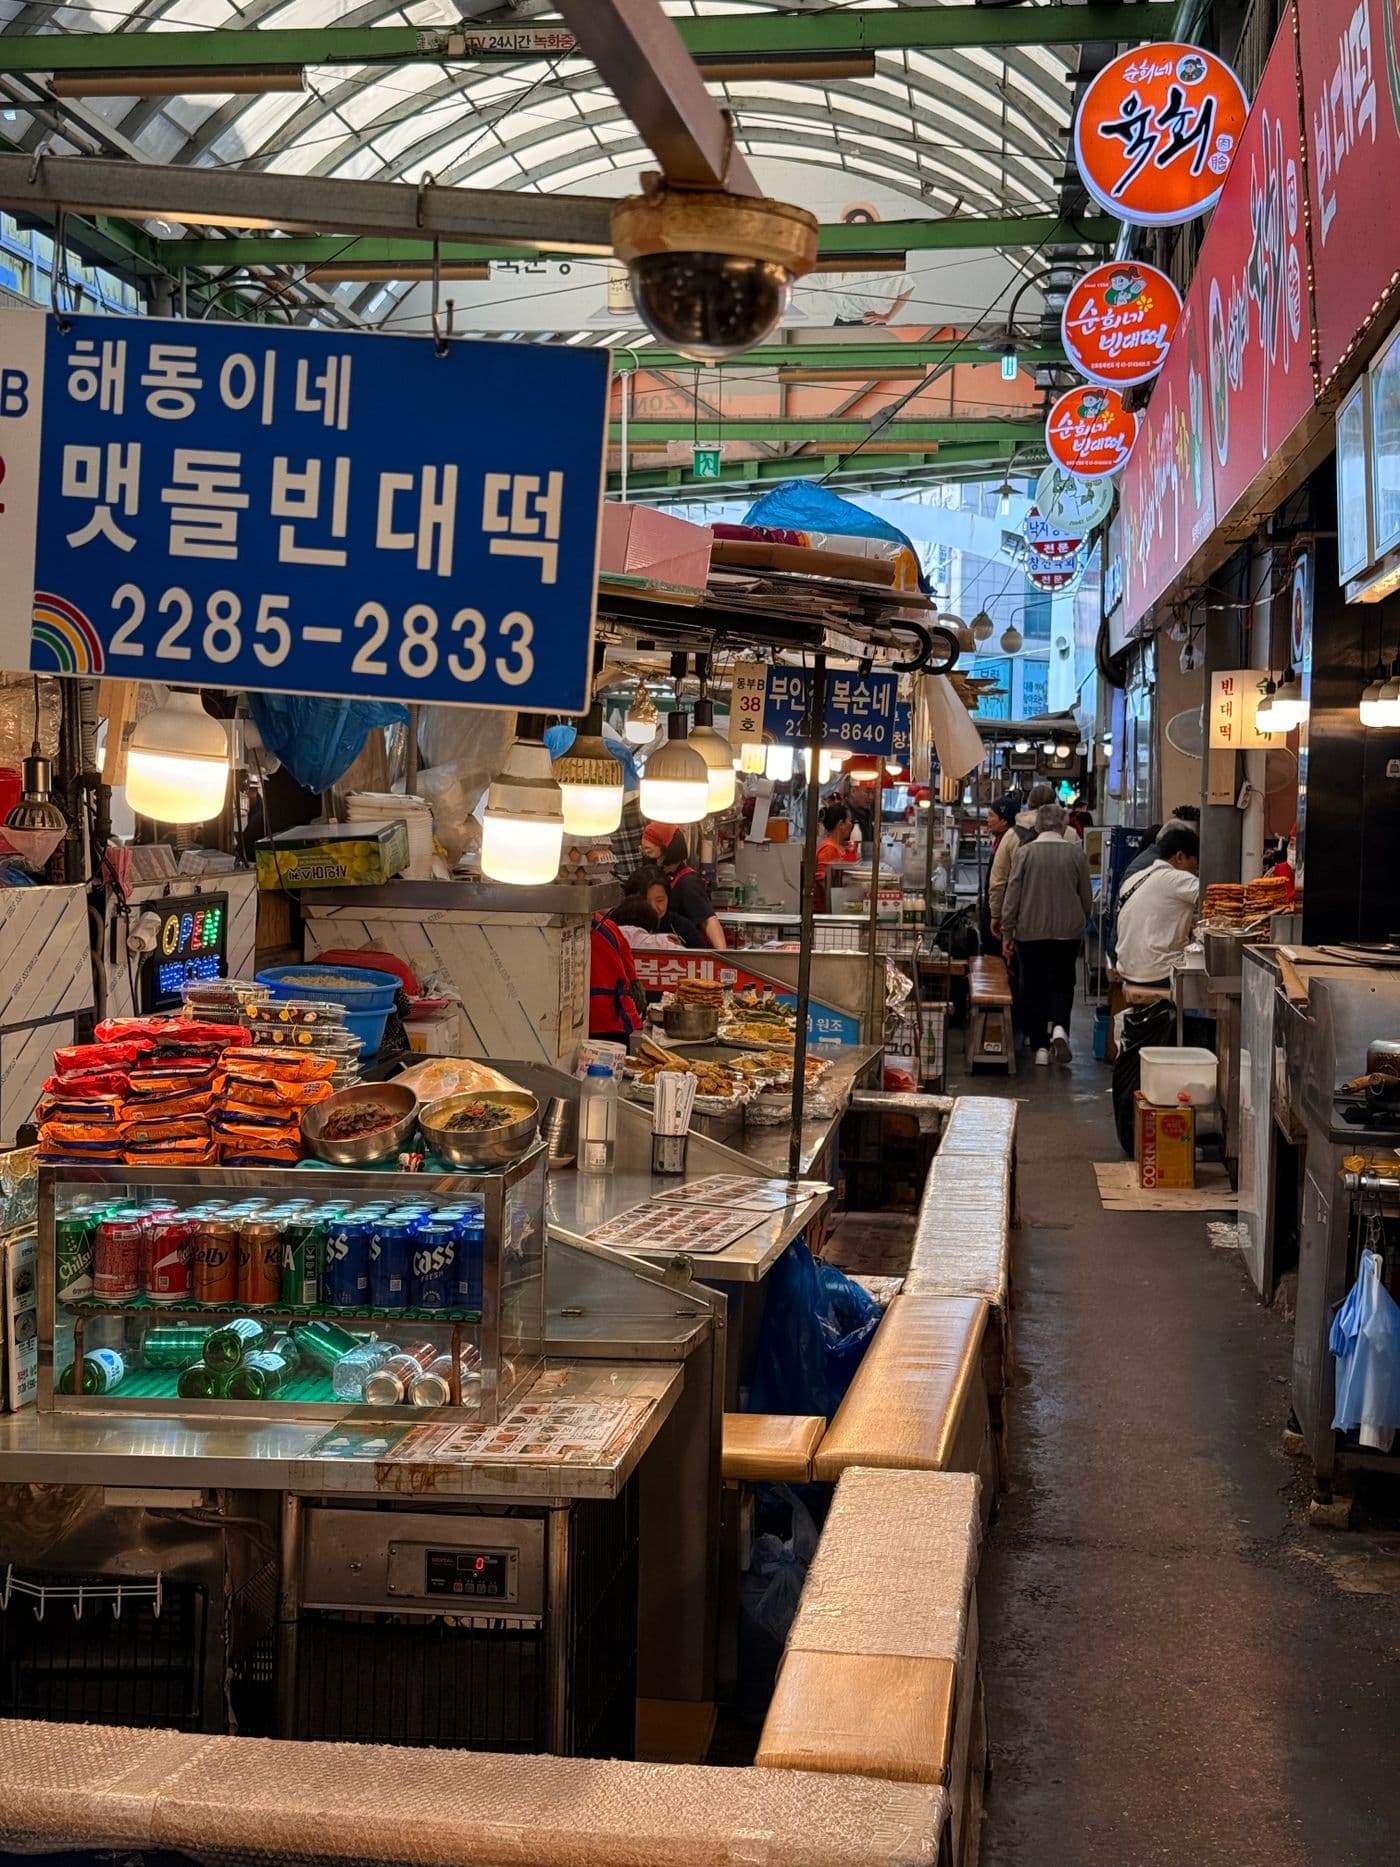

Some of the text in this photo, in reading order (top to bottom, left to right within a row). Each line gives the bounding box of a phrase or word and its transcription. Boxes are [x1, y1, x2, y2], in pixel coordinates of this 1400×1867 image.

[488, 37, 531, 49] 24시간
[533, 34, 575, 49] 녹화중
[1123, 59, 1172, 84] 순희네
[1098, 85, 1217, 198] 육회
[1067, 299, 1145, 335] 순희네
[1099, 323, 1170, 364] 빈대떡
[68, 340, 352, 430] 해동이네
[1049, 412, 1108, 440] 순희네
[1072, 432, 1128, 464] 빈대떡
[61, 442, 564, 584] 맷돌빈대떡
[108, 583, 535, 686] 2285-2833
[736, 677, 765, 692] 동부B
[831, 680, 890, 717] 복순네
[740, 696, 761, 711] 38
[1219, 677, 1234, 742] 빈대떡
[739, 717, 756, 732] 호
[162, 908, 220, 956] OPEN
[633, 959, 715, 986] 복순네
[816, 1017, 843, 1033] 원조
[1142, 1142, 1157, 1188] CORN
[475, 1557, 484, 1570] 0
